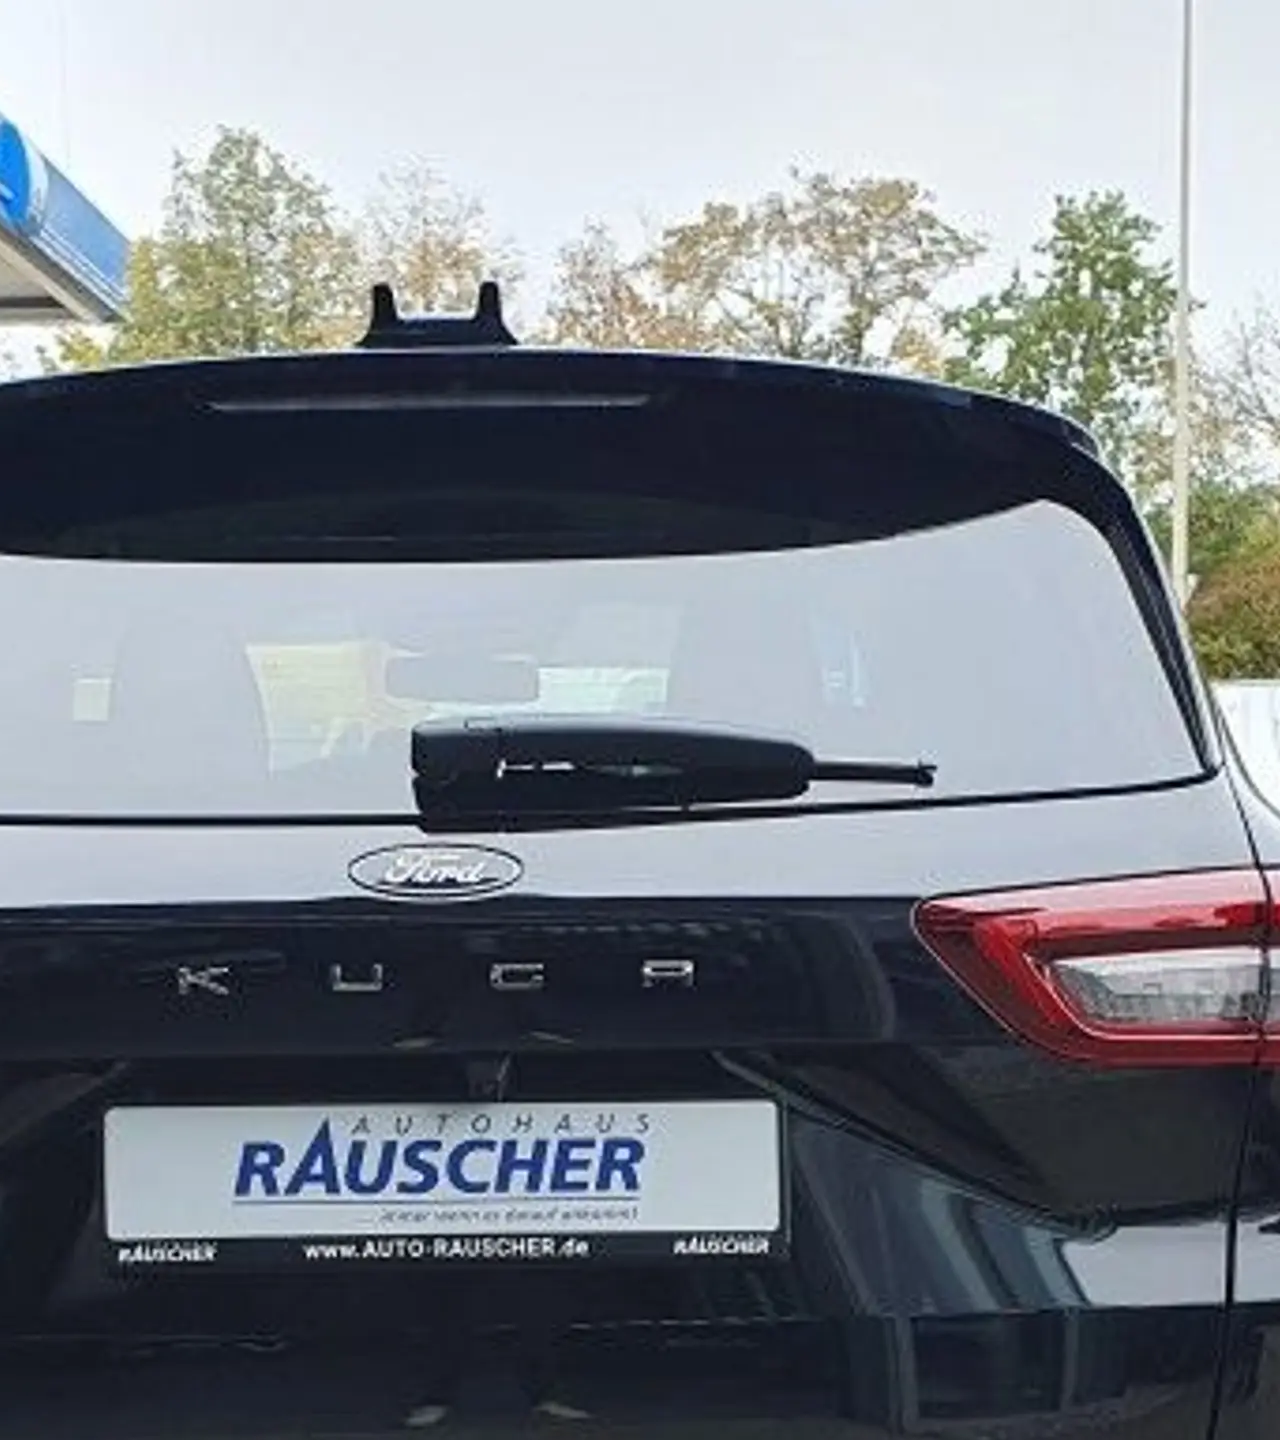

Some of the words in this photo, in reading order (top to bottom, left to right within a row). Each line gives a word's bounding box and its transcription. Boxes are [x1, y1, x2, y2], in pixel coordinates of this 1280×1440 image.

[384, 855, 486, 883] Ford
[177, 958, 695, 996] KUGA
[351, 1113, 651, 1134] AUTOHAUS
[233, 1117, 646, 1197] RAUSCHER
[303, 1235, 590, 1260] www.AUTO-RAUSCHER.de
